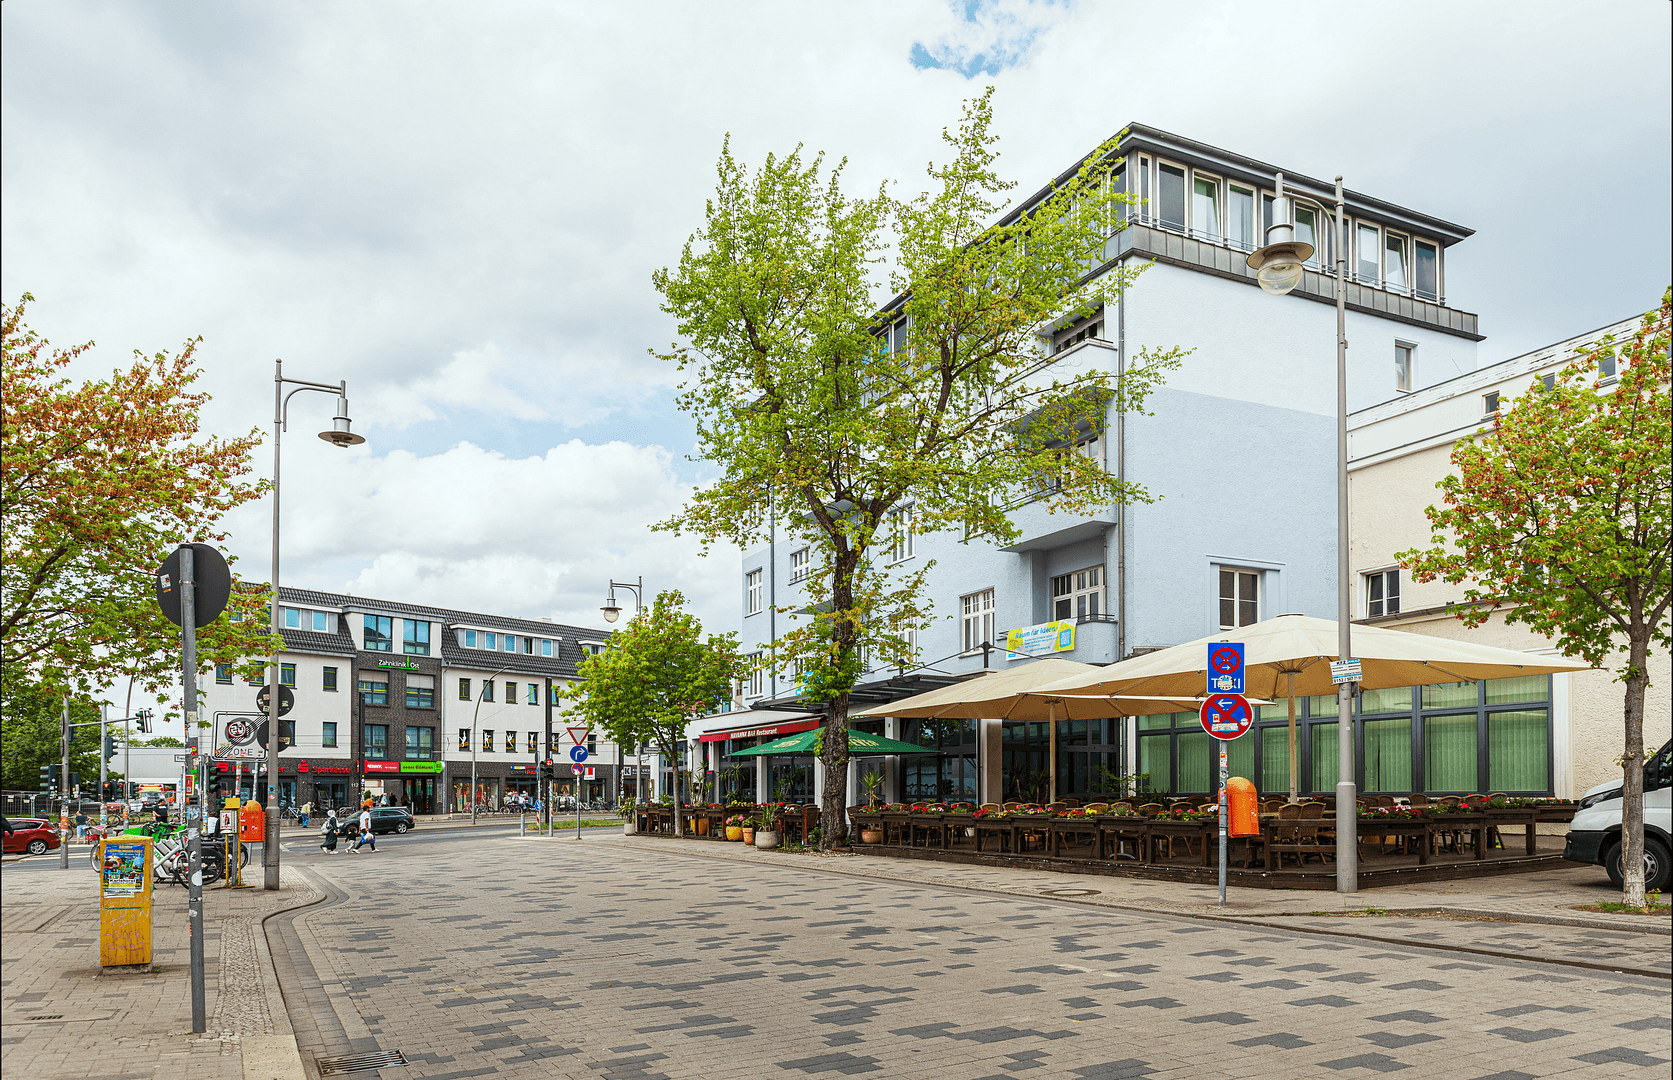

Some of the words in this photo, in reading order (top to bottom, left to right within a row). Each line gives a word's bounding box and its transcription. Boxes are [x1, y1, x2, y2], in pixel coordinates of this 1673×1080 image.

[378, 659, 407, 668] Zahnklinik
[1211, 678, 1241, 689] TXI
[756, 728, 778, 736] Restaurant
[312, 765, 351, 775] Sparkasse
